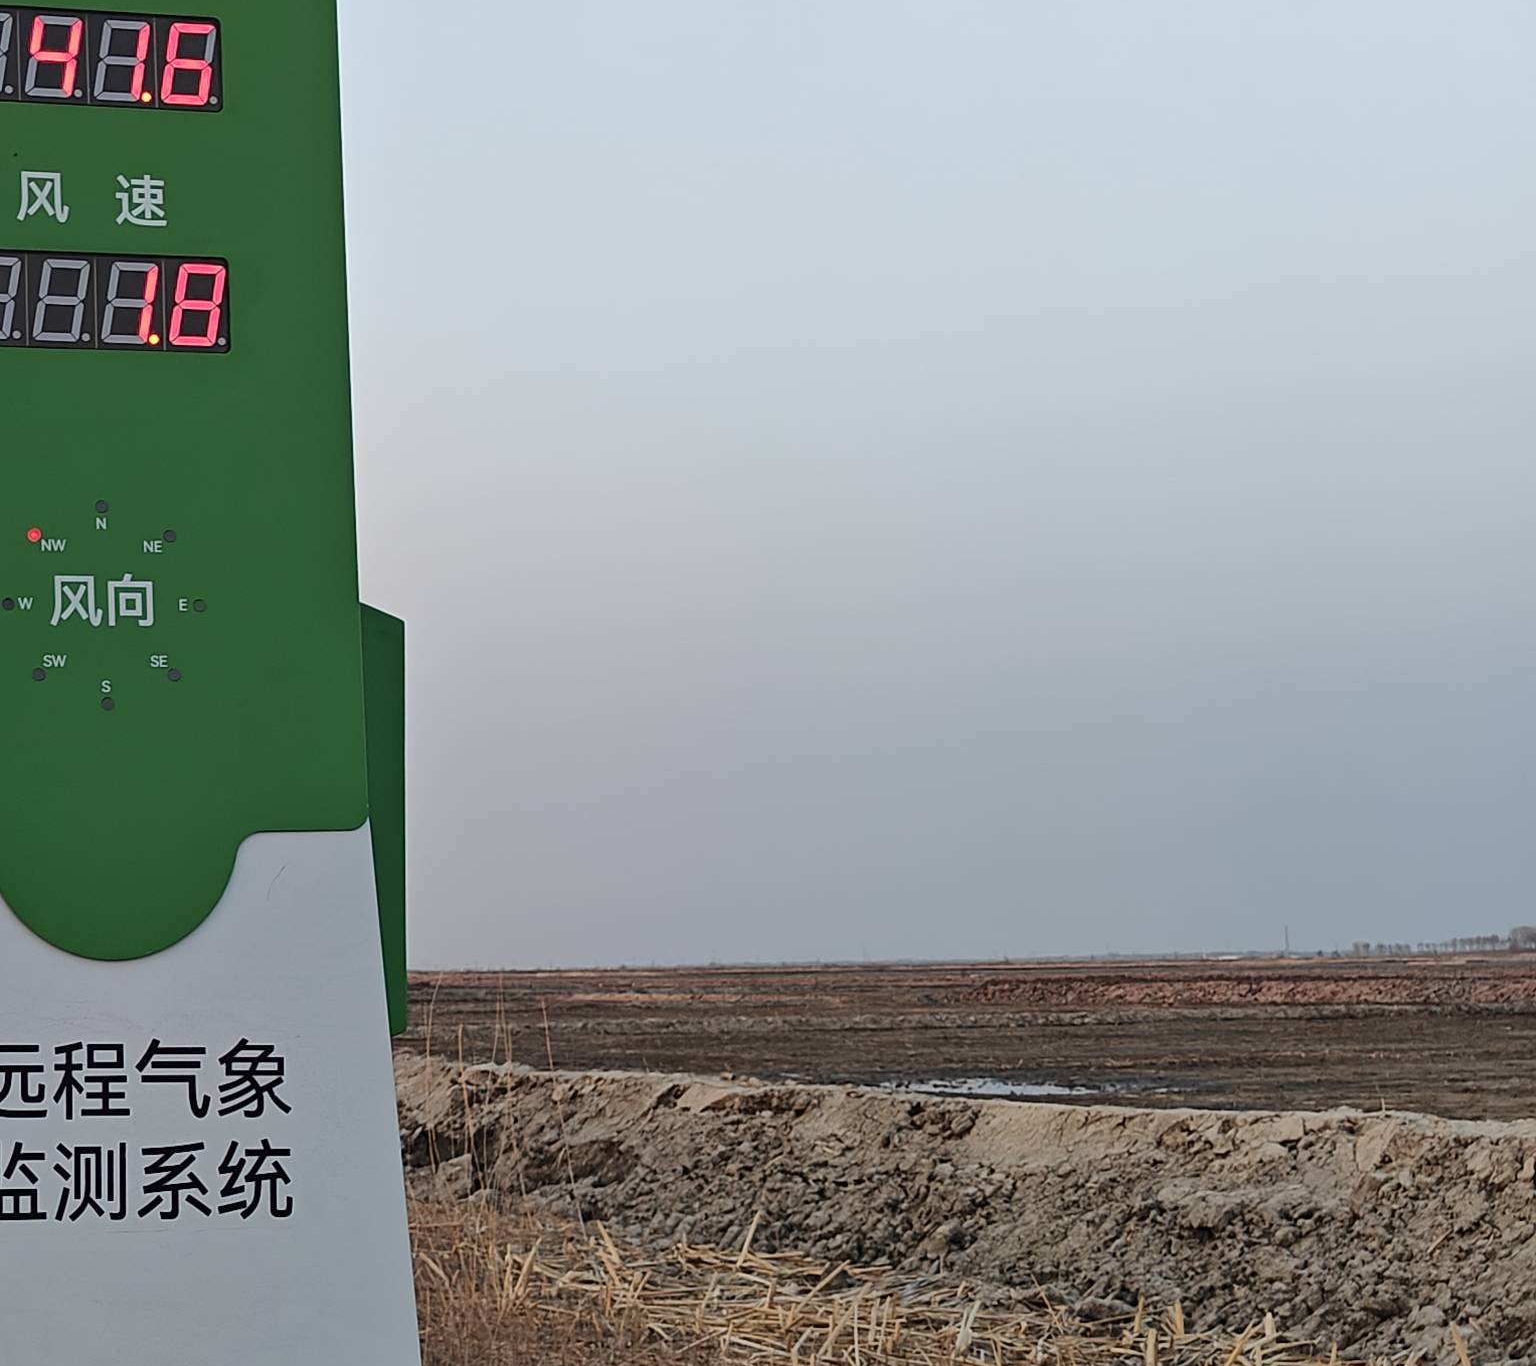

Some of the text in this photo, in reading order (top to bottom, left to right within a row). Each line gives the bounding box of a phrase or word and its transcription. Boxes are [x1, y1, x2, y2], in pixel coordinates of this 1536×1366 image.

[16, 170, 168, 227] 风速
[95, 517, 107, 530] N
[40, 538, 67, 552] NW
[142, 540, 163, 553] NE
[17, 597, 33, 610] W
[50, 573, 154, 627] 风向
[178, 599, 188, 612] E
[42, 654, 67, 668] SW
[150, 655, 168, 668] SE
[101, 680, 111, 693] S
